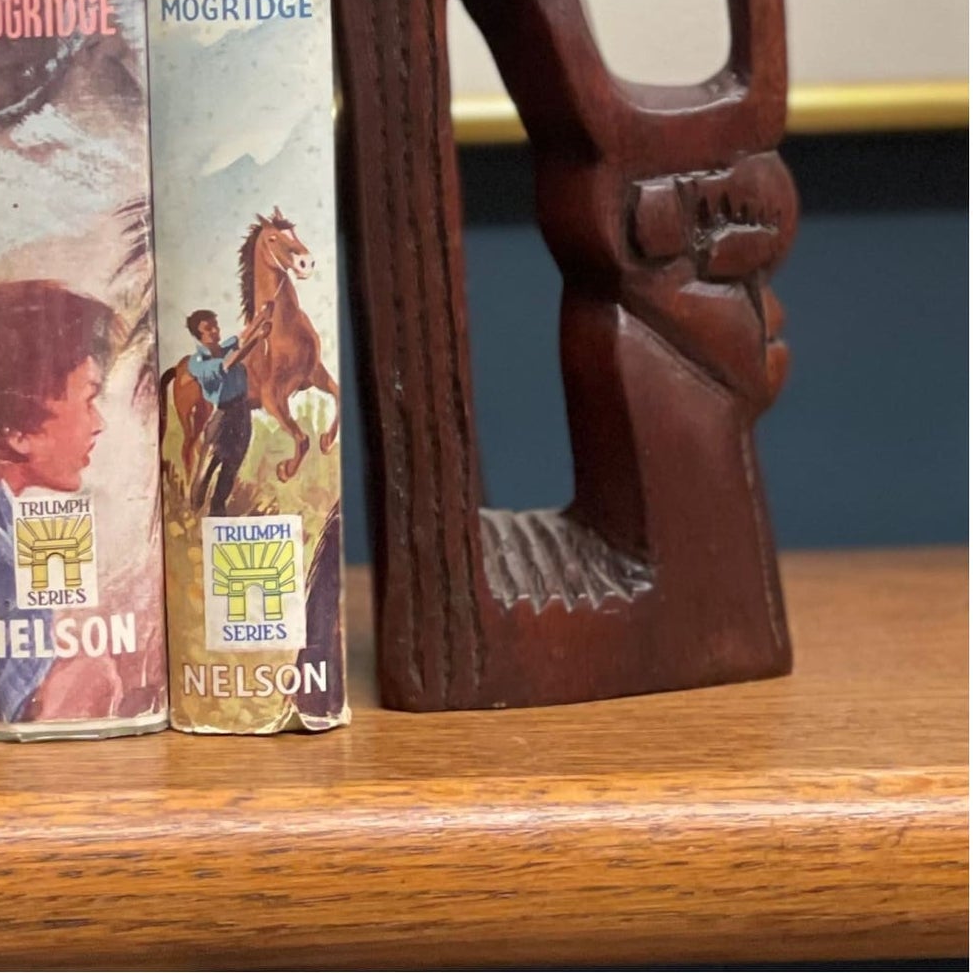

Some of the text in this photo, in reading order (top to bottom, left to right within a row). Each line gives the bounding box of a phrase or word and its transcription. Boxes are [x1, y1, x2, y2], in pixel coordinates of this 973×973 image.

[19, 498, 91, 517] TRIUMPH
[213, 523, 291, 542] TRIUMPH
[27, 588, 87, 605] SERIES
[222, 623, 287, 642] SERIES
[183, 660, 328, 698] NELSON
